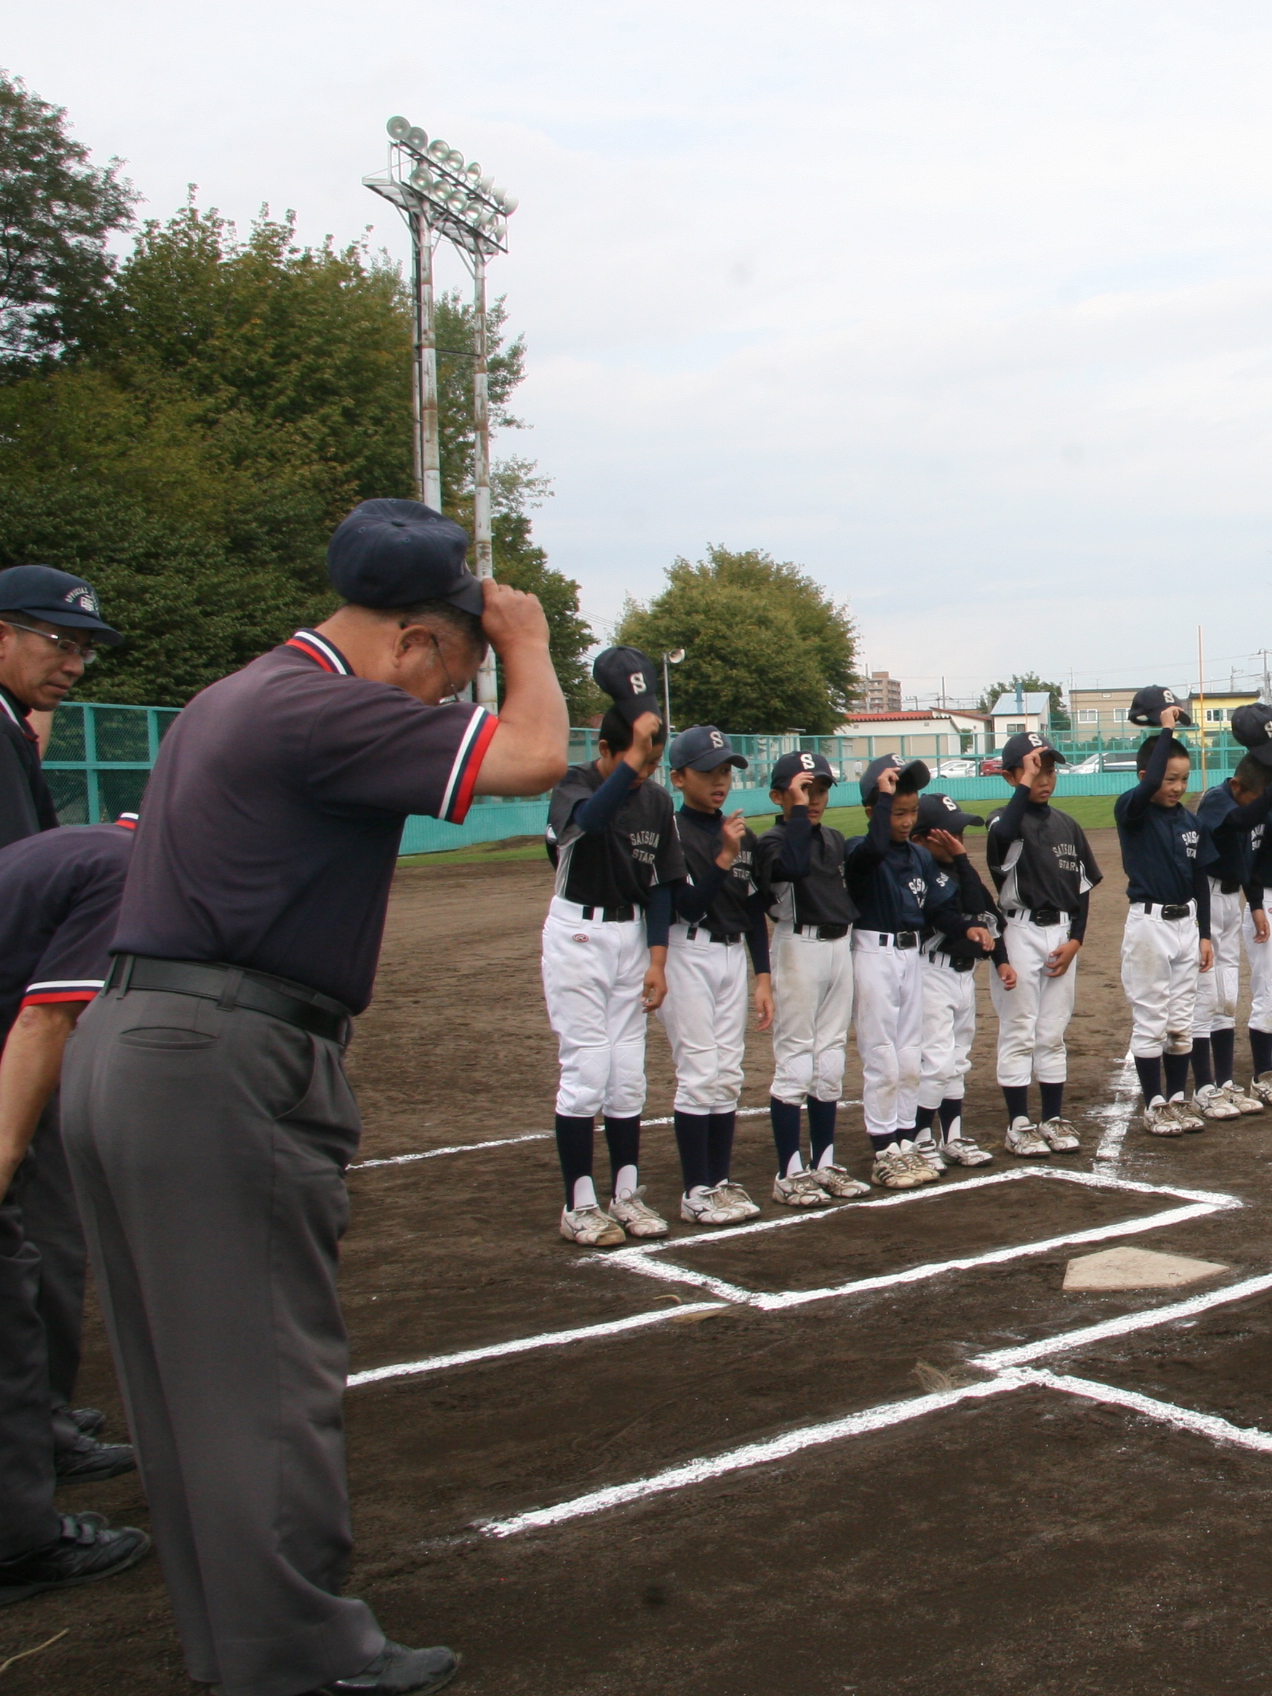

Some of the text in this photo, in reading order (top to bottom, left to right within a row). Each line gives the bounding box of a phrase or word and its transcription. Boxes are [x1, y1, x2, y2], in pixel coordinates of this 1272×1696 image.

[629, 672, 647, 695] S
[1162, 689, 1175, 703] S
[710, 731, 724, 749] S
[1028, 733, 1043, 747] S
[800, 753, 815, 770] S
[942, 796, 957, 811] S
